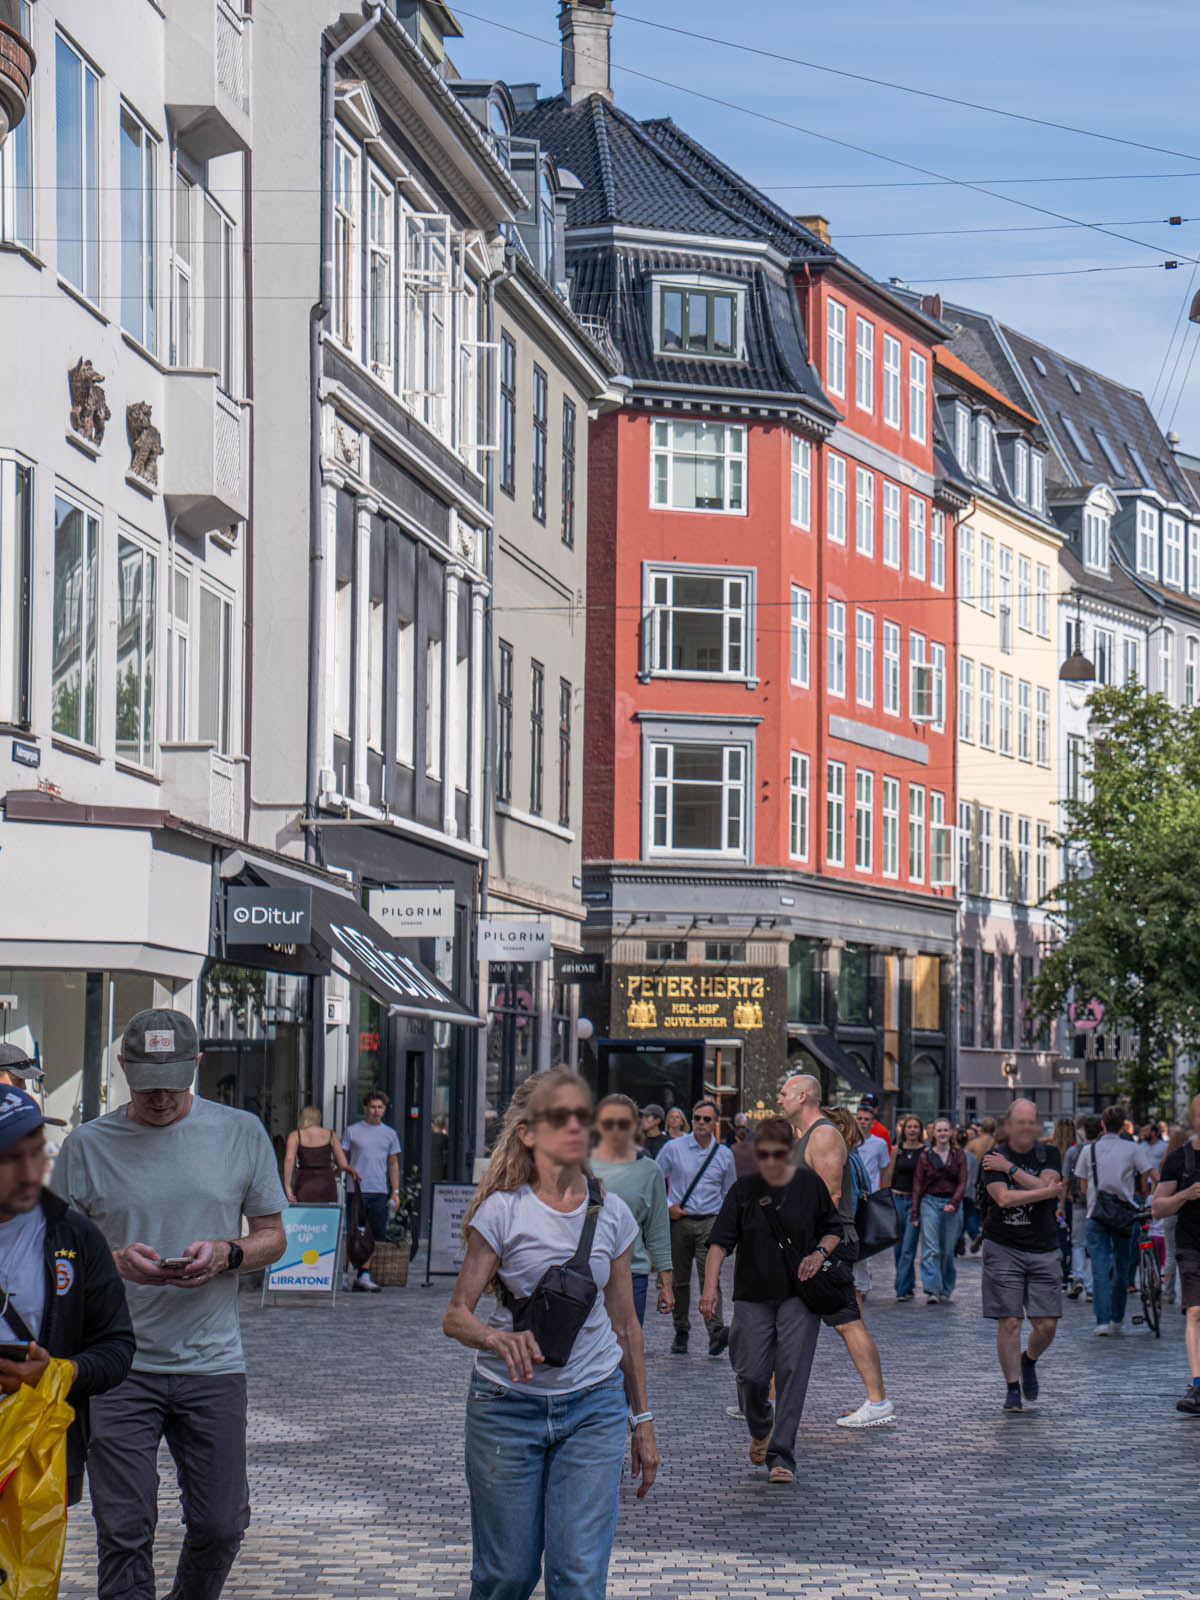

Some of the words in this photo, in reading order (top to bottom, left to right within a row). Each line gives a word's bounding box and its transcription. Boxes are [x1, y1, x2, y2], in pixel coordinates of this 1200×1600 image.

[252, 906, 304, 925] Ditur
[382, 907, 442, 917] PILGRIM
[484, 931, 545, 942] PILGRIM
[627, 976, 695, 998] PETER
[700, 976, 764, 998] HERTZ
[664, 1017, 727, 1028] JUVELERER
[271, 1276, 329, 1286] LIBRATONE
